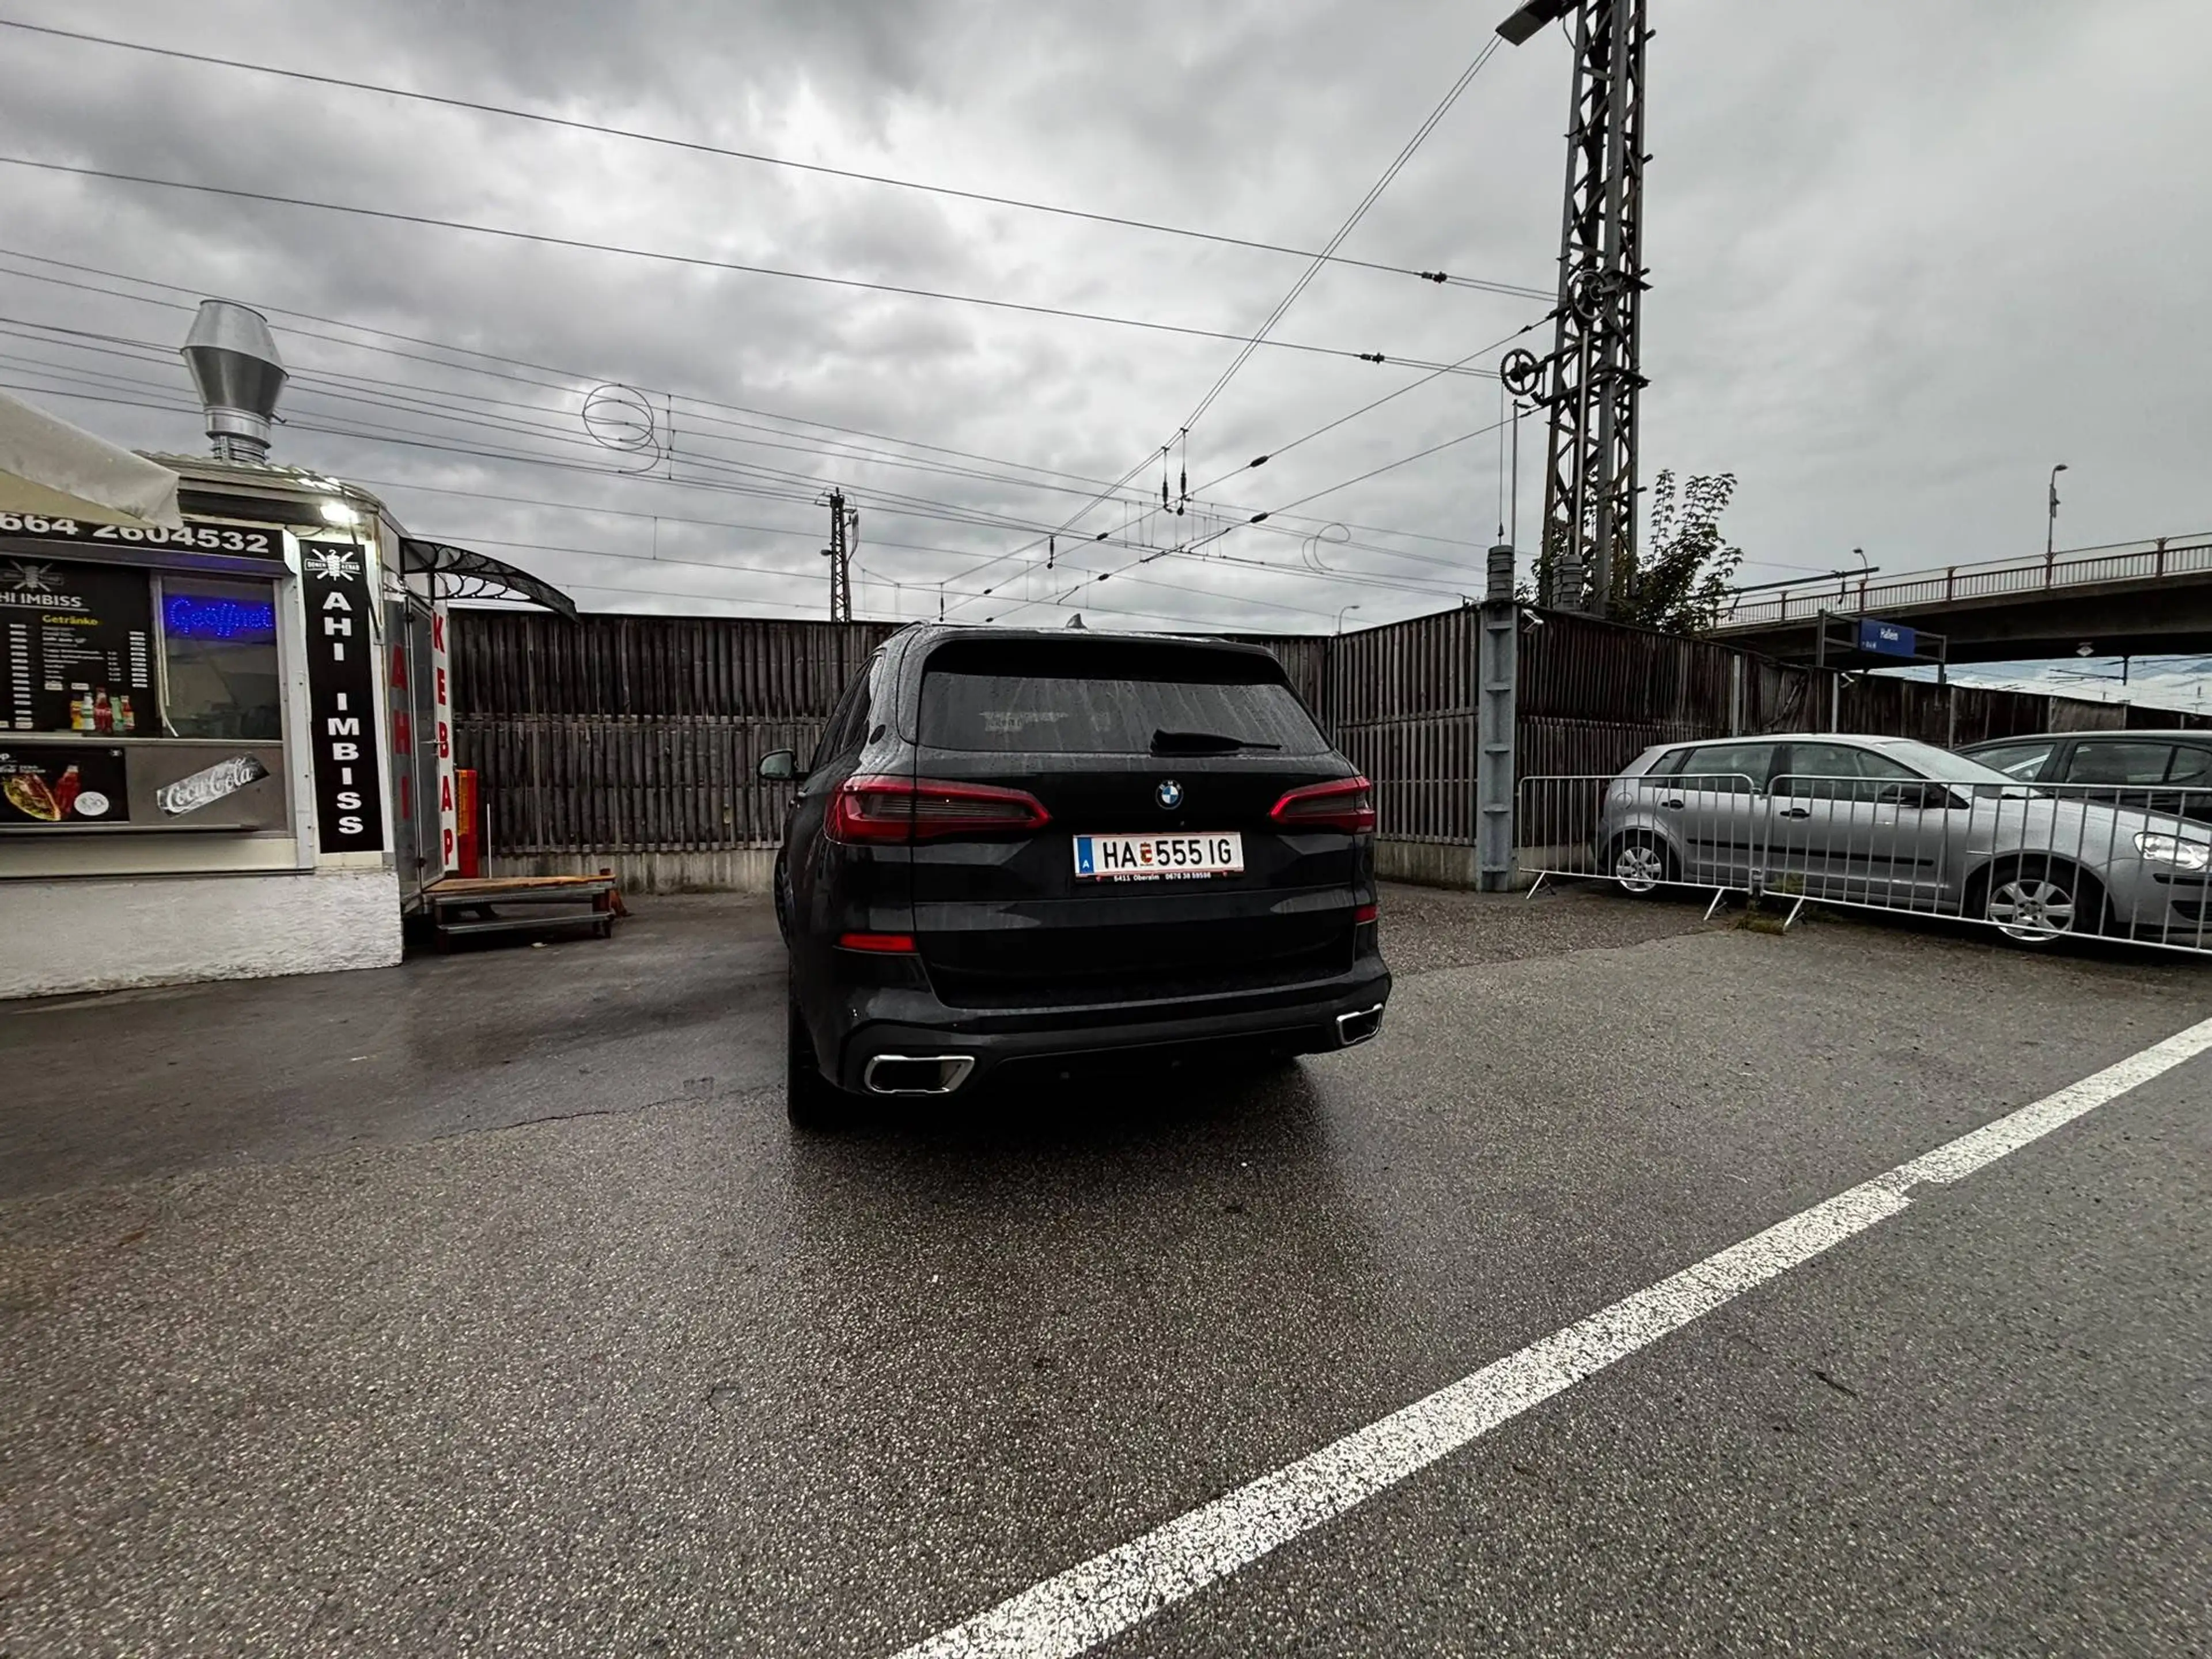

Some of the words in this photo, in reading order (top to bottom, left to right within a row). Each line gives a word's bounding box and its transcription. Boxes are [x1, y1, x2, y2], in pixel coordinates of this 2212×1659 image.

[93, 525, 269, 554] 2604532
[21, 593, 82, 608] IMBISS
[323, 592, 353, 661] AHI
[391, 645, 411, 820] AHI
[432, 613, 453, 865] KEBAP
[328, 692, 364, 834] IMBISS
[1082, 860, 1089, 869] A
[1103, 842, 1137, 869] HA
